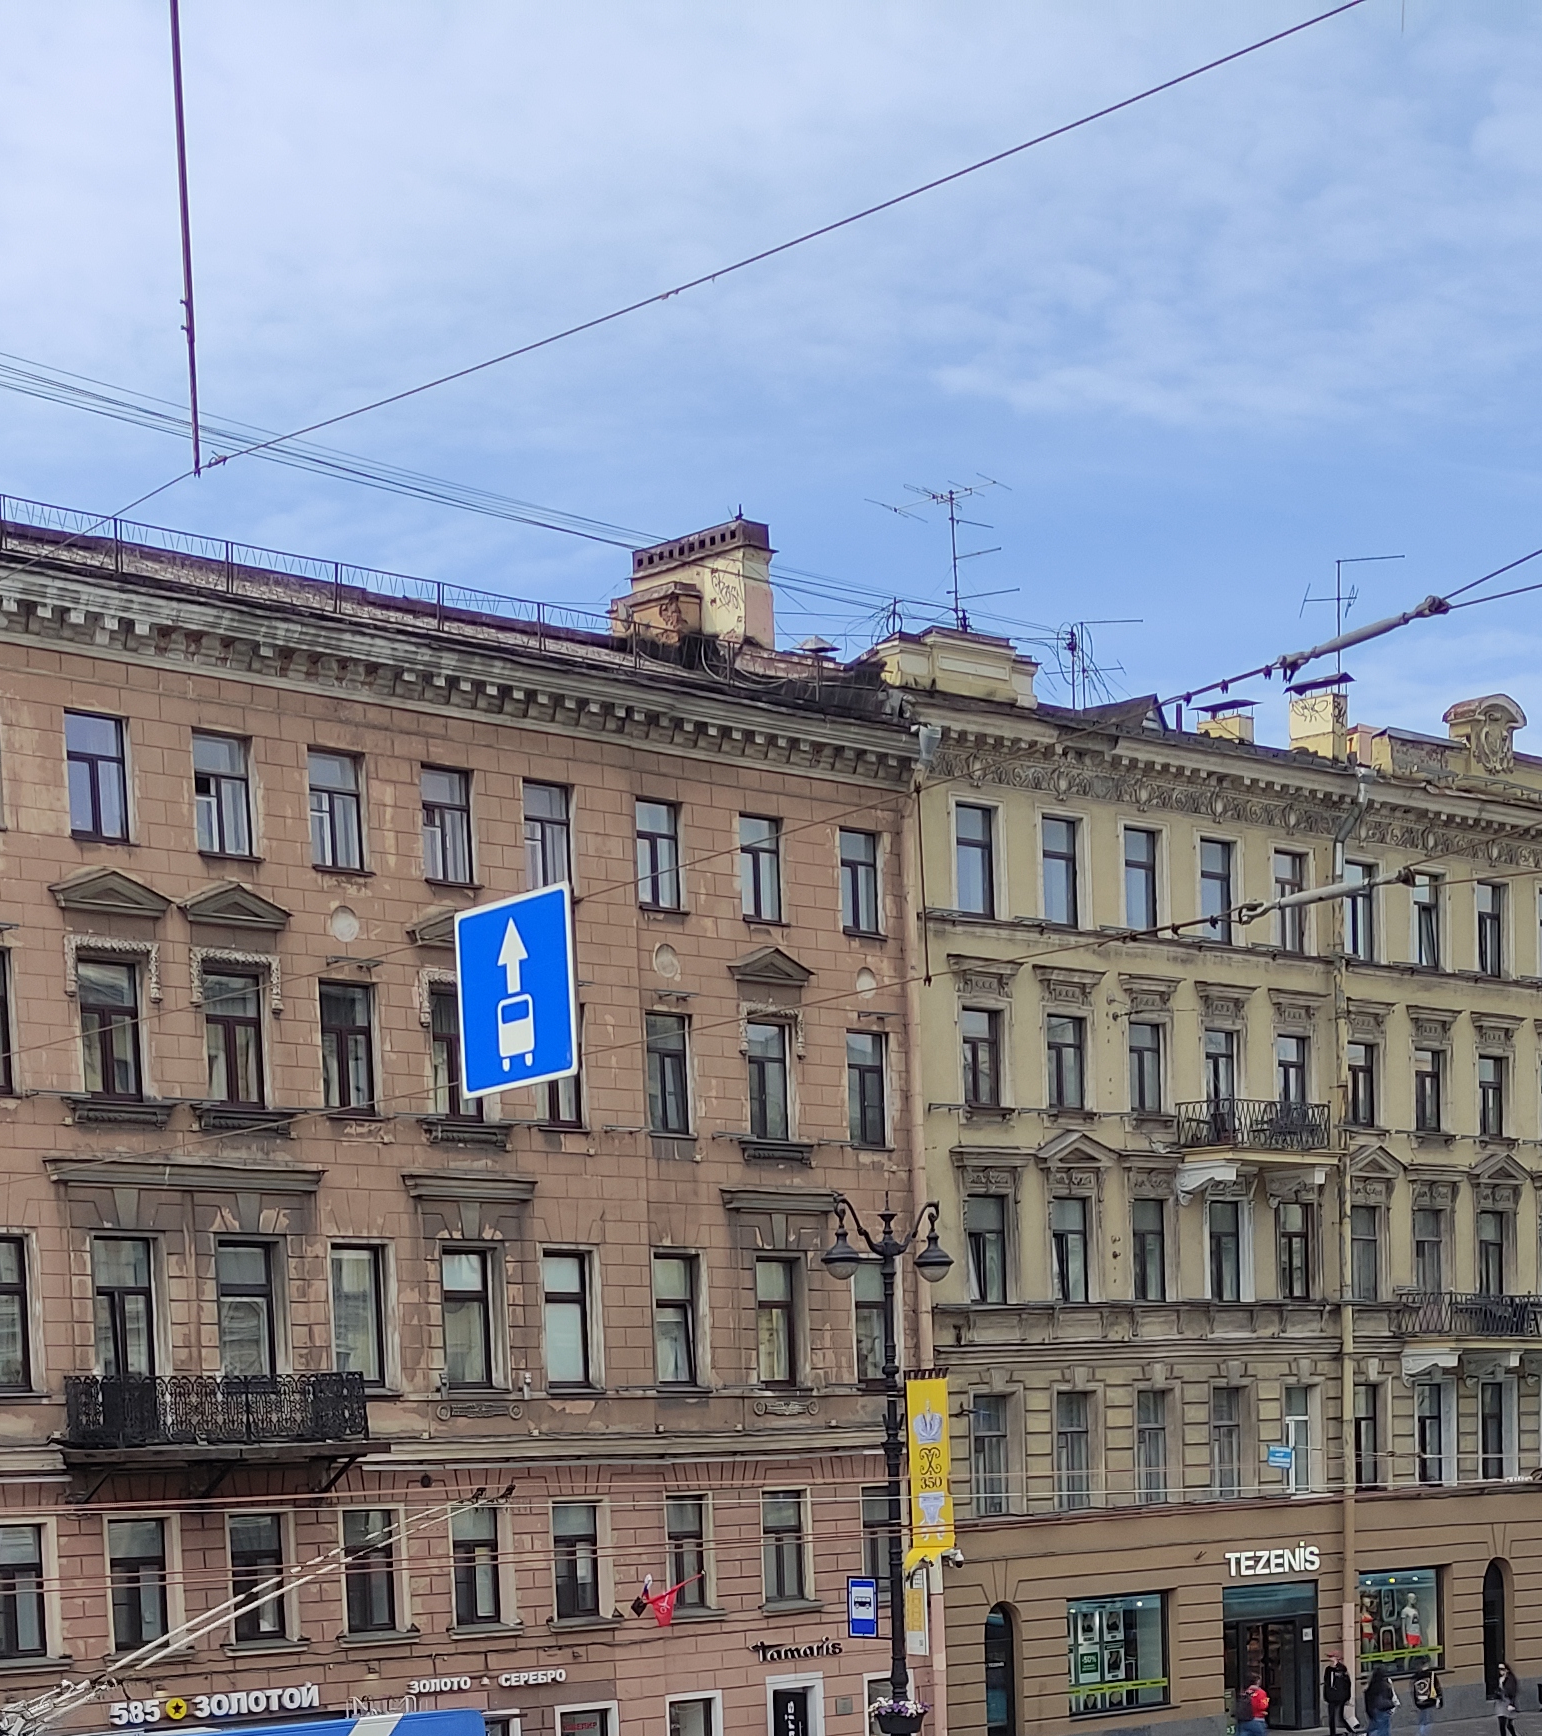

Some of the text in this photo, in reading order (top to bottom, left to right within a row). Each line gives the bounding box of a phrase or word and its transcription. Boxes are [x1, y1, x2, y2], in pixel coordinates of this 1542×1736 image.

[920, 1476, 943, 1490] 350
[407, 1668, 567, 1695] ЗОЛОТО СЕРЕБРО
[109, 1681, 321, 1726] 585 ЗОЛОТОЙ
